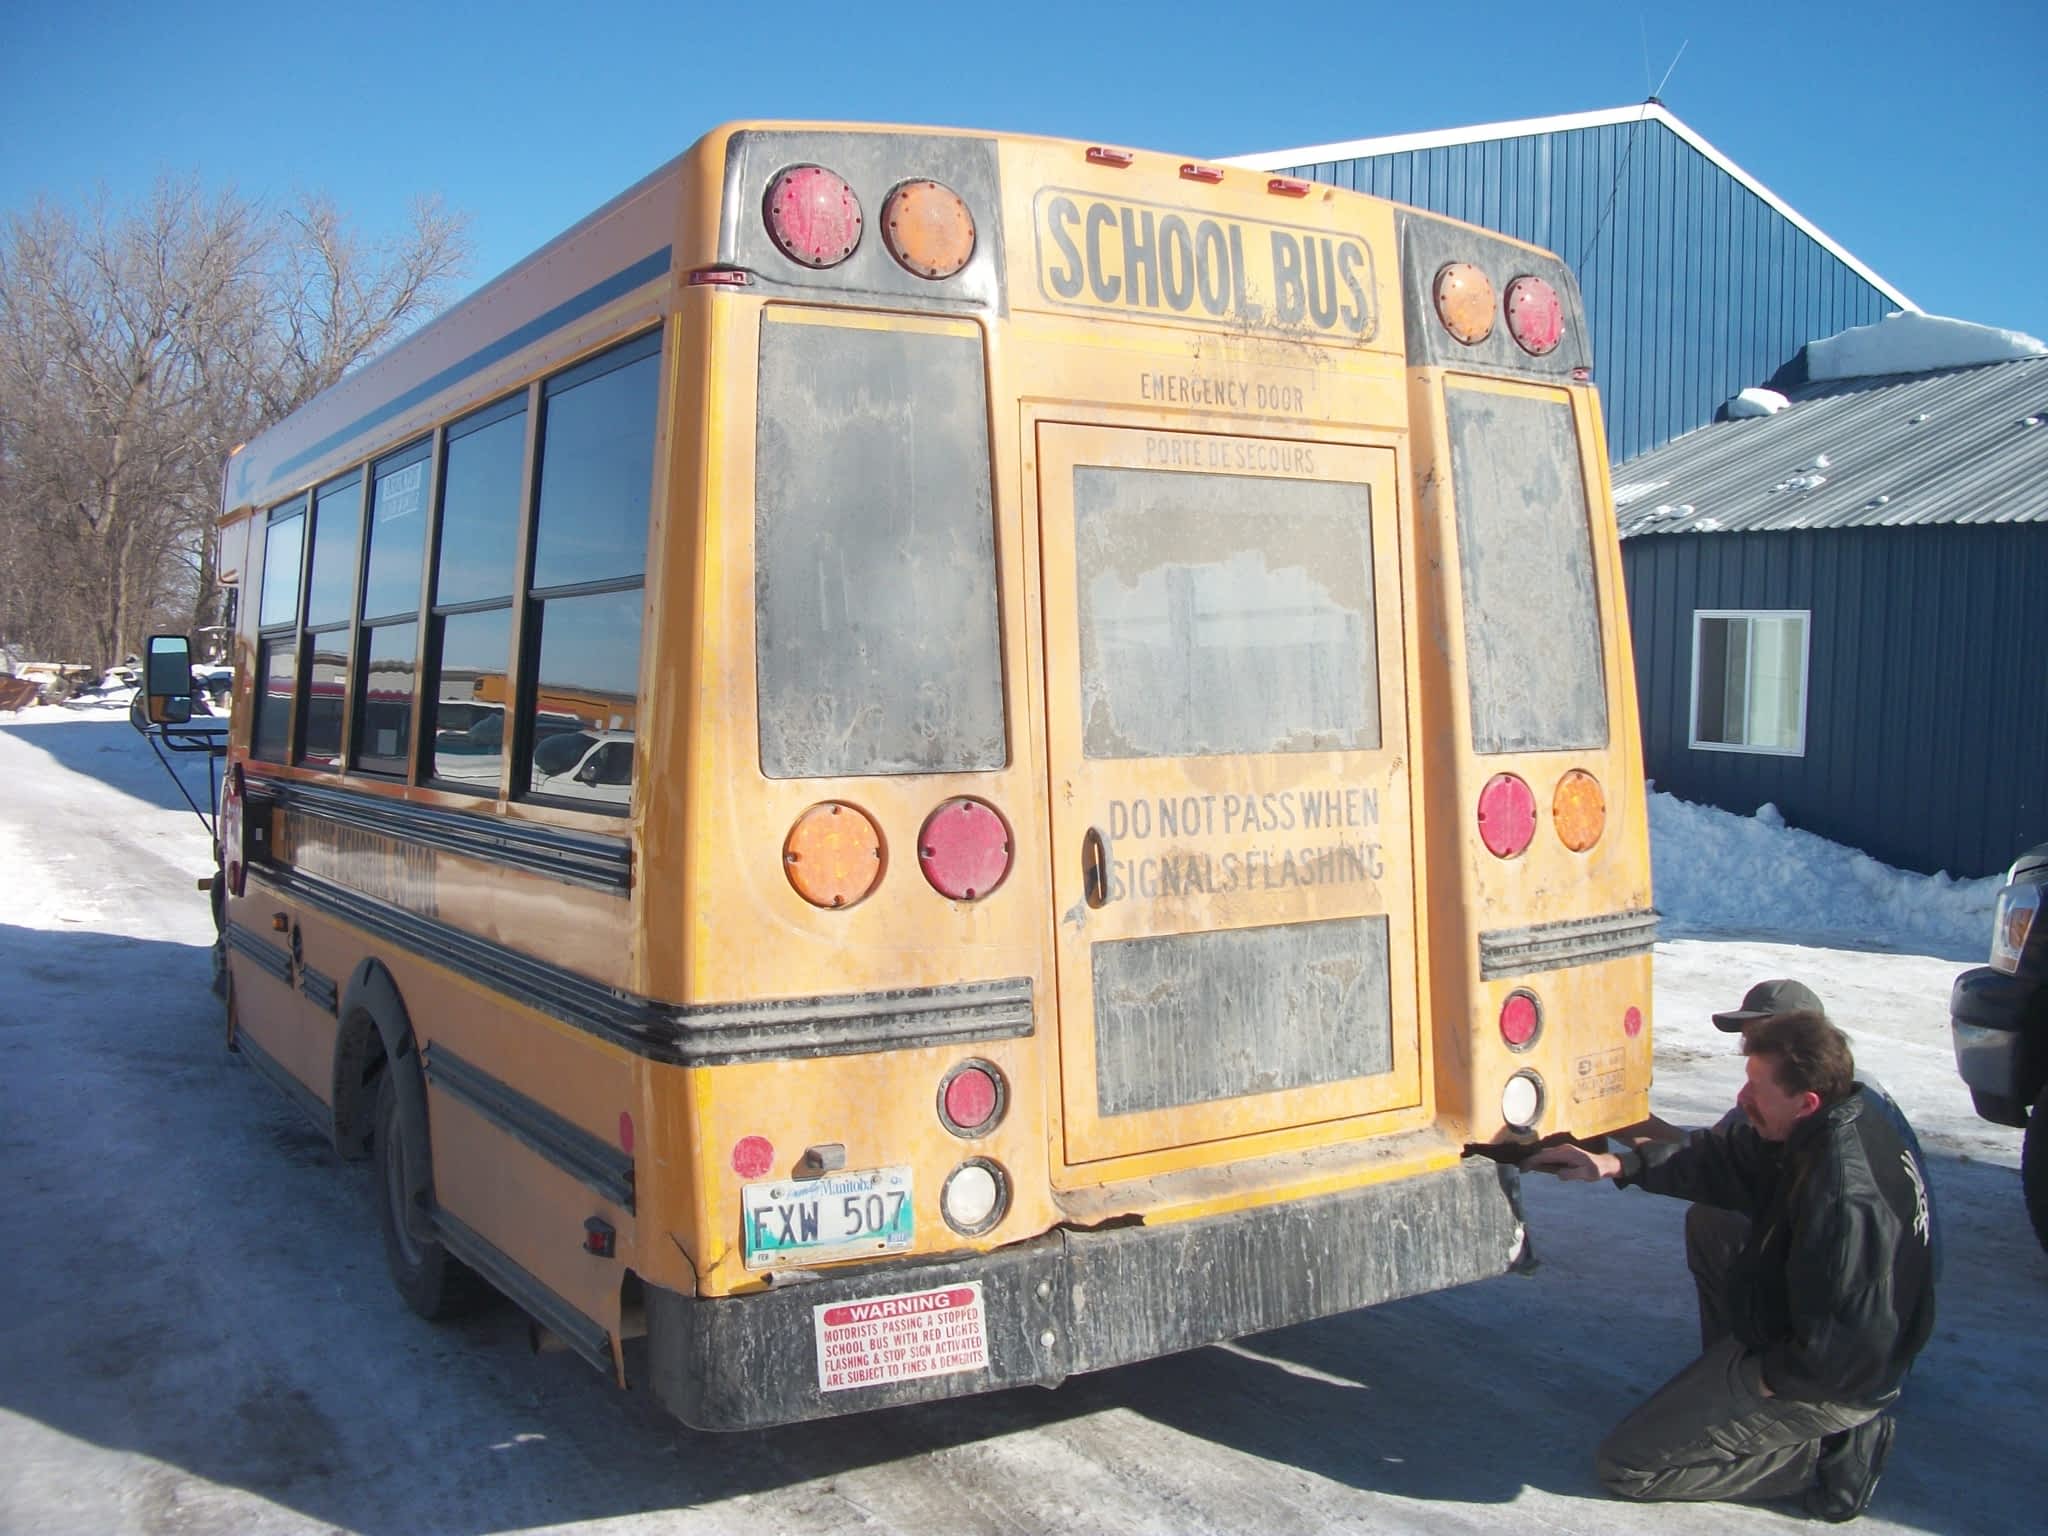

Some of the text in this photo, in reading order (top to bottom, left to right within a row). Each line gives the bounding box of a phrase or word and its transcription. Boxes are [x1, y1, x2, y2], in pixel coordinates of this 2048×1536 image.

[1047, 197, 1368, 333] SCHOOL BUS
[1140, 372, 1303, 413] EMERGENCY DOOR
[1145, 437, 1315, 474] PORTE DE SECOURS
[1109, 787, 1380, 841] DO NOT PASS WHEN
[1110, 842, 1385, 902] SIGNALS FLASHING
[821, 1177, 874, 1196] Manitoba
[754, 1190, 905, 1249] FXW 507
[849, 1293, 951, 1320] WARNING
[824, 1308, 978, 1343] MOTORISTS PASSING A STOPPED
[826, 1322, 979, 1358] SCHOOL BUS WITH RED LIGHTS
[825, 1335, 982, 1373] FLASHING & STOP SIGN ACTIVATED
[826, 1350, 984, 1387] ARE SUBJECT TO FINES & DEMERITS
